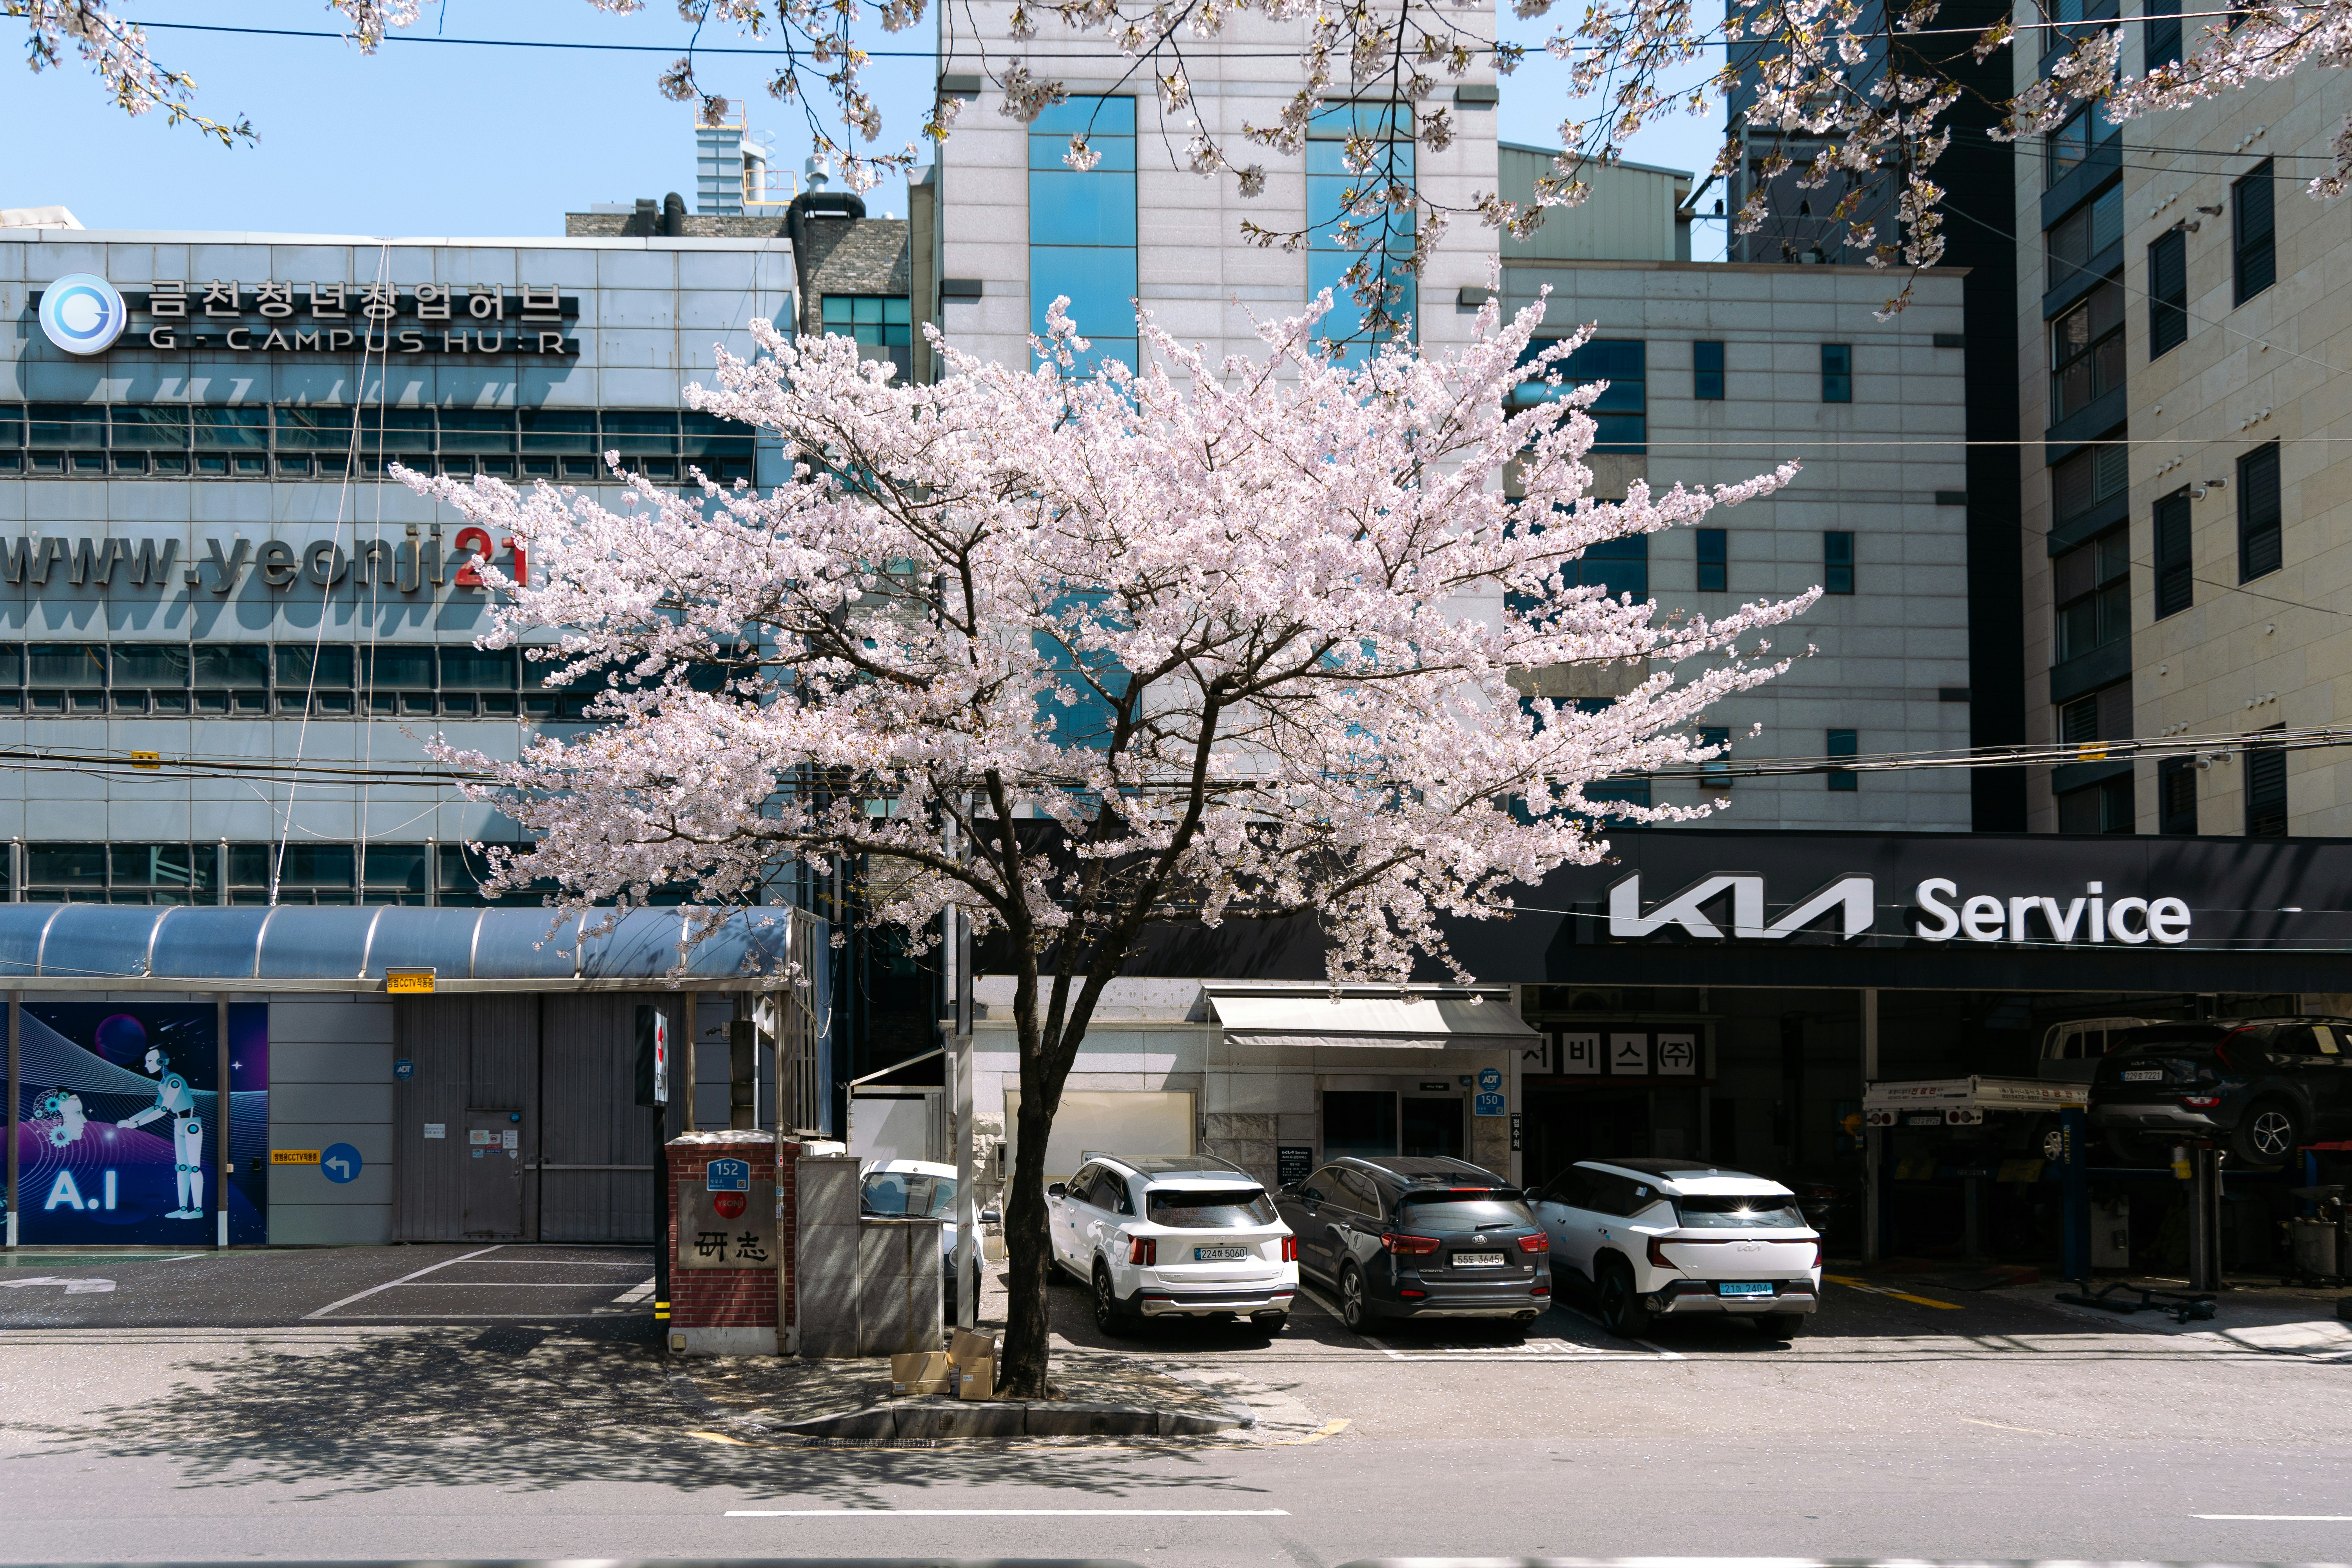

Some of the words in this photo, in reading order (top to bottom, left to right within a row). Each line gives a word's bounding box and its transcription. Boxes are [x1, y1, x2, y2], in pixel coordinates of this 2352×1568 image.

[149, 279, 562, 323] 금천청년창업허브
[1610, 875, 1874, 941] KIA
[1916, 878, 2191, 944] Service
[1482, 1075, 1498, 1084] ADT
[2144, 1071, 2160, 1080] 7221
[1481, 1095, 1498, 1104] 150
[717, 1163, 738, 1175] 152
[44, 1171, 116, 1209] A.I
[694, 1231, 769, 1262] 研志
[1201, 1249, 1223, 1258] 224하
[1225, 1249, 1245, 1258] 5060
[1457, 1255, 1474, 1264] 55도
[1478, 1255, 1499, 1263] 3645
[1746, 1284, 1768, 1293] 2404
